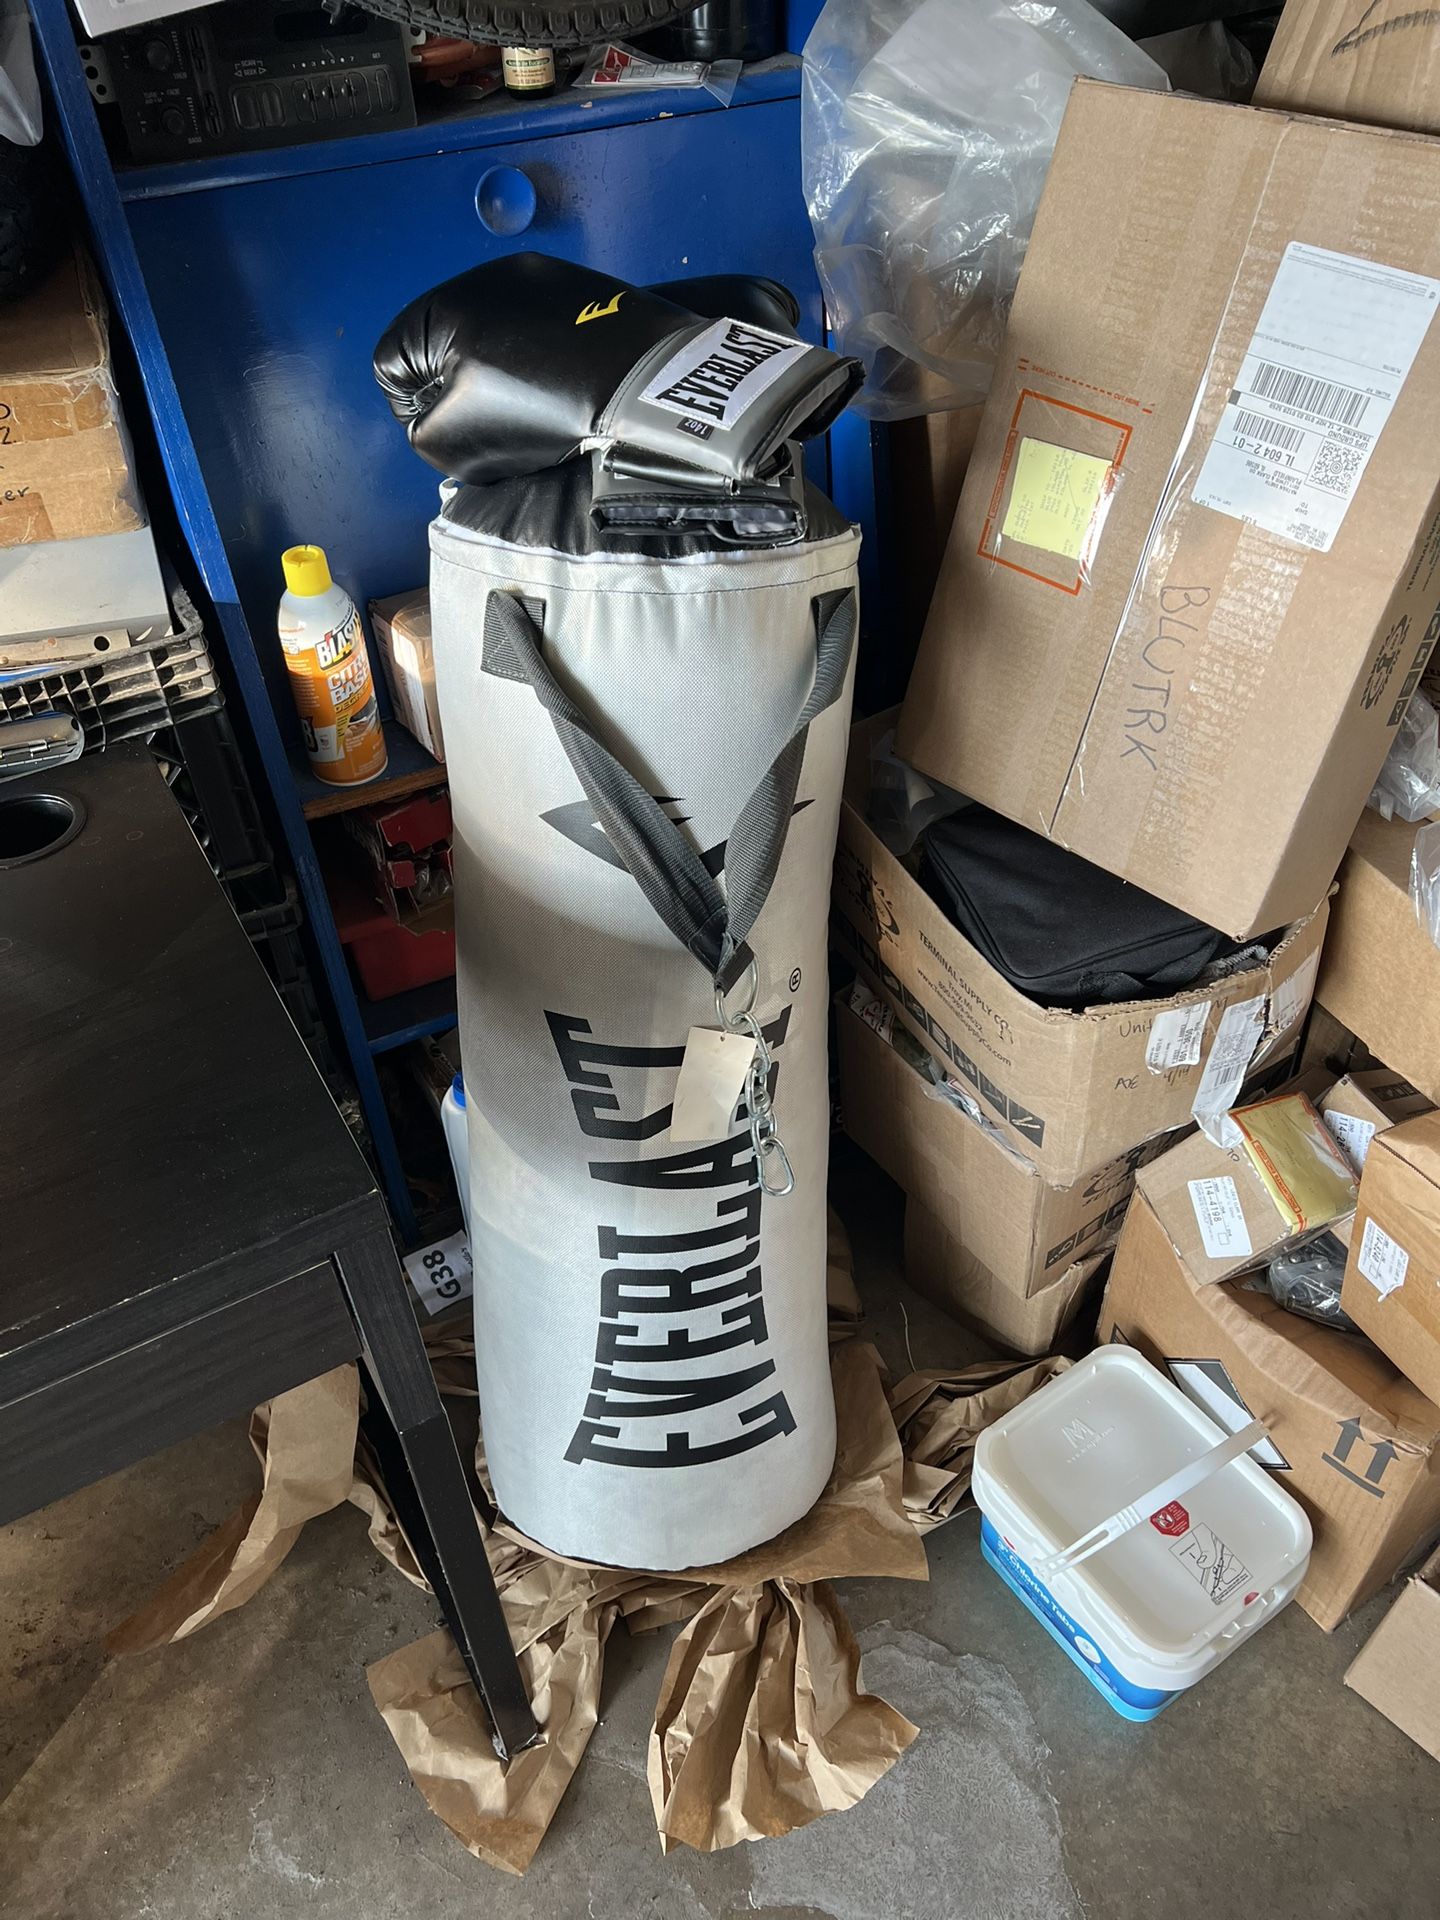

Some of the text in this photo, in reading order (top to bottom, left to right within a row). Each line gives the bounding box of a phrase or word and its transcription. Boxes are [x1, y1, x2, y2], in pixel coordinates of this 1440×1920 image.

[655, 323, 799, 422] EVERLAST
[1327, 429, 1368, 448] UPS GROUND
[1341, 427, 1371, 442] TRACKING
[1263, 446, 1282, 461] 604
[1283, 453, 1295, 466] IL
[1256, 470, 1270, 479] CLARK
[1273, 469, 1302, 484] PLAINFIELD
[1293, 505, 1308, 515] SHIP
[918, 929, 958, 983] TERMINAL
[959, 978, 993, 1016] SUPPLY
[1254, 1143, 1297, 1210] DOCUMENTS ENCLOSED
[1203, 1180, 1226, 1223] 114-4198
[543, 1003, 798, 1468] EVERLAST
[422, 1249, 462, 1299] G38
[1009, 1553, 1051, 1606] Chlorine
[1051, 1602, 1076, 1635] Tabs
